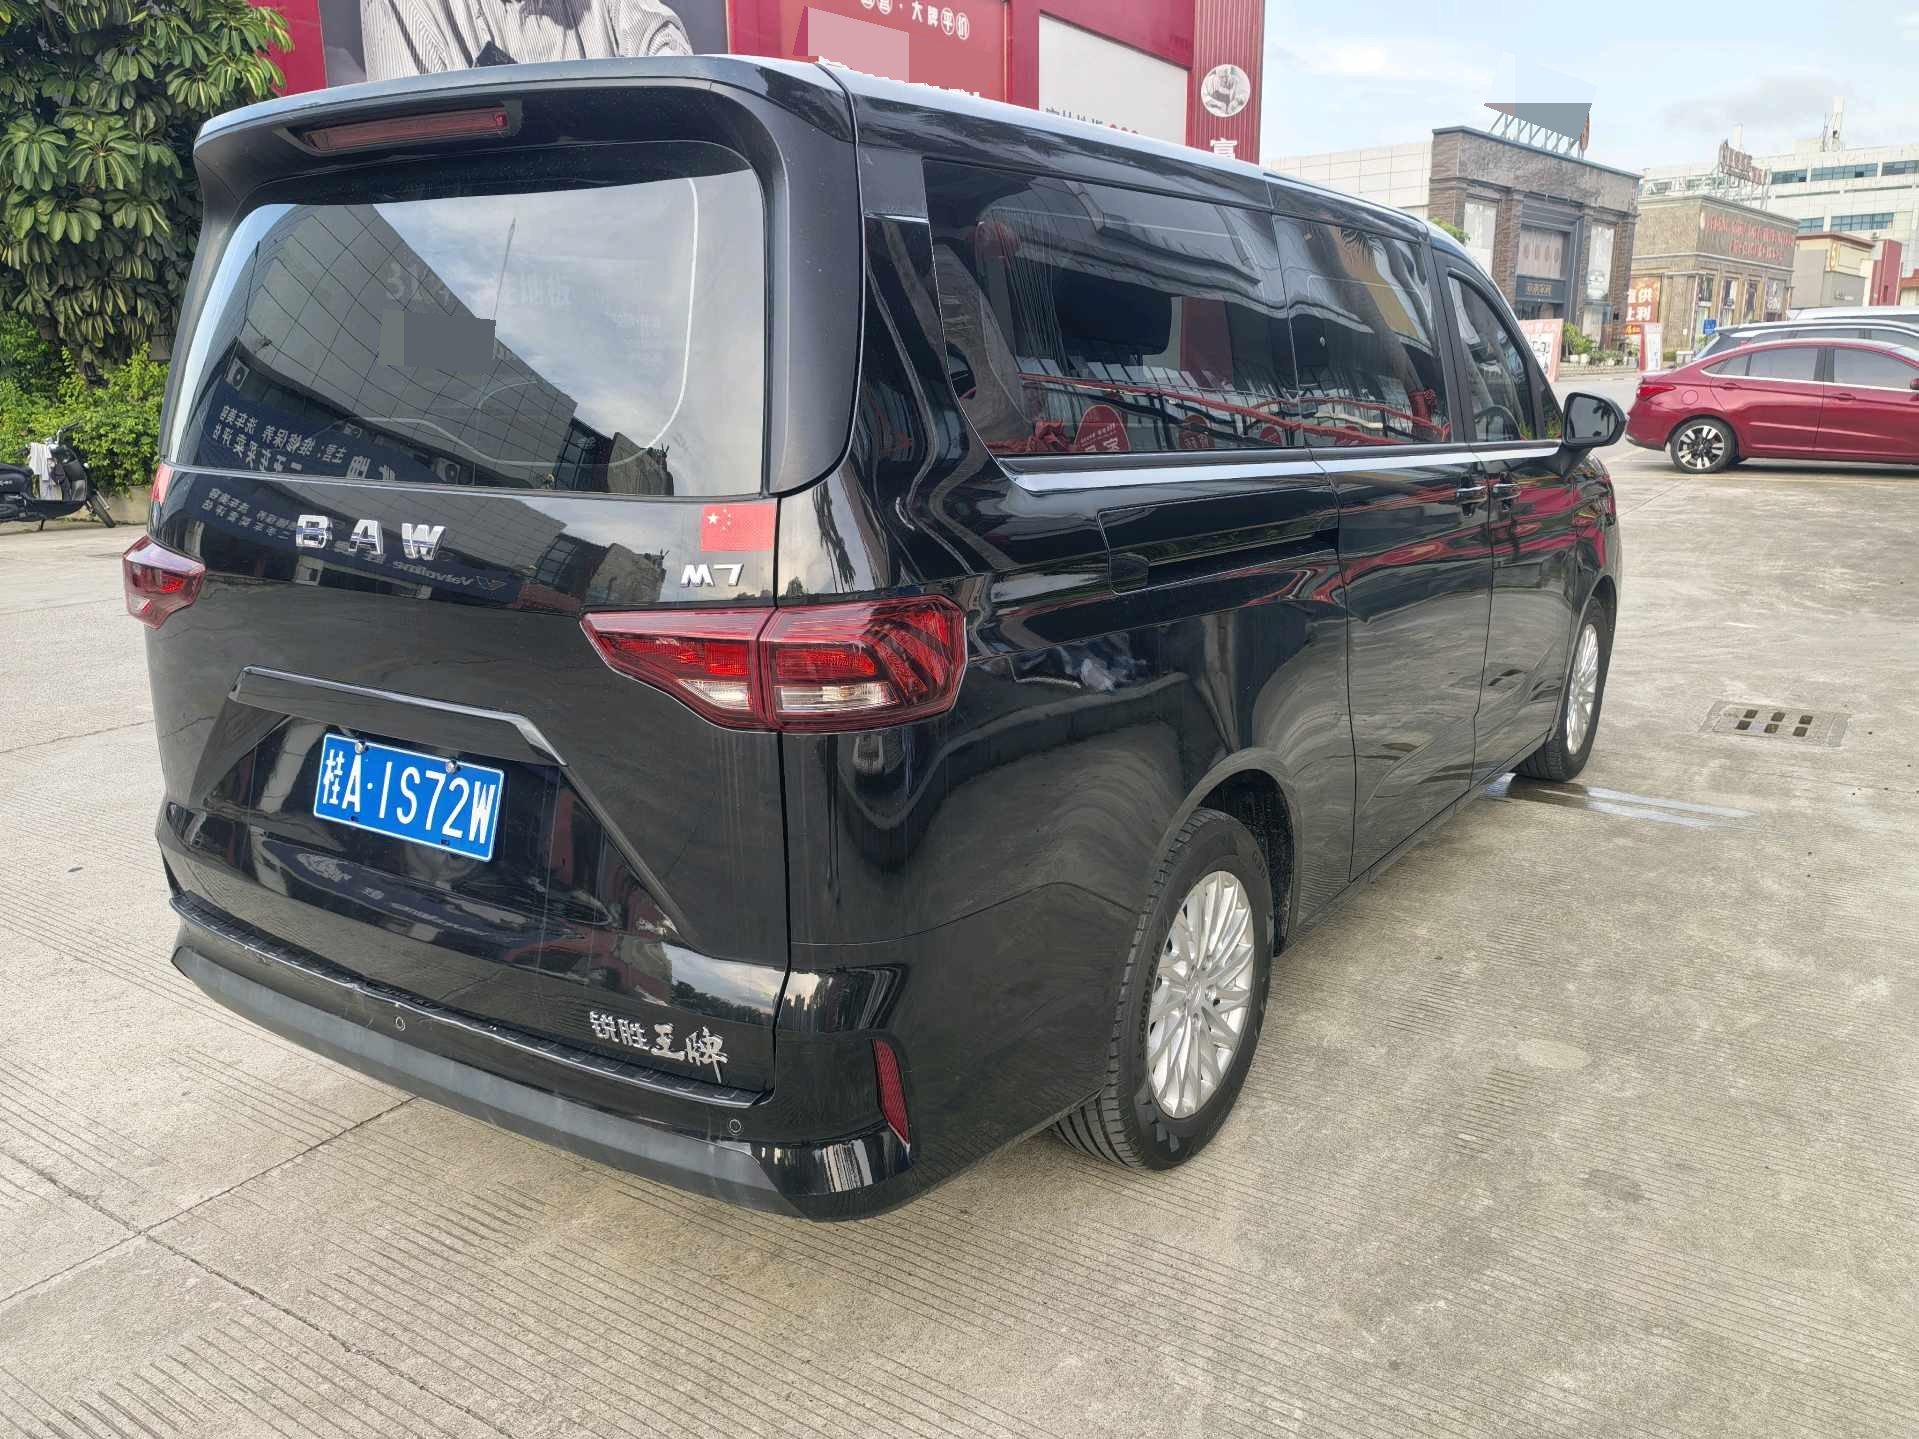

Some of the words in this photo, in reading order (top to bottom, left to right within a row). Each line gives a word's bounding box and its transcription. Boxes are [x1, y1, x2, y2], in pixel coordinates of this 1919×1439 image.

[296, 514, 446, 561] BAW
[680, 563, 744, 587] M7
[589, 1010, 729, 1084] 锐胜王牌
